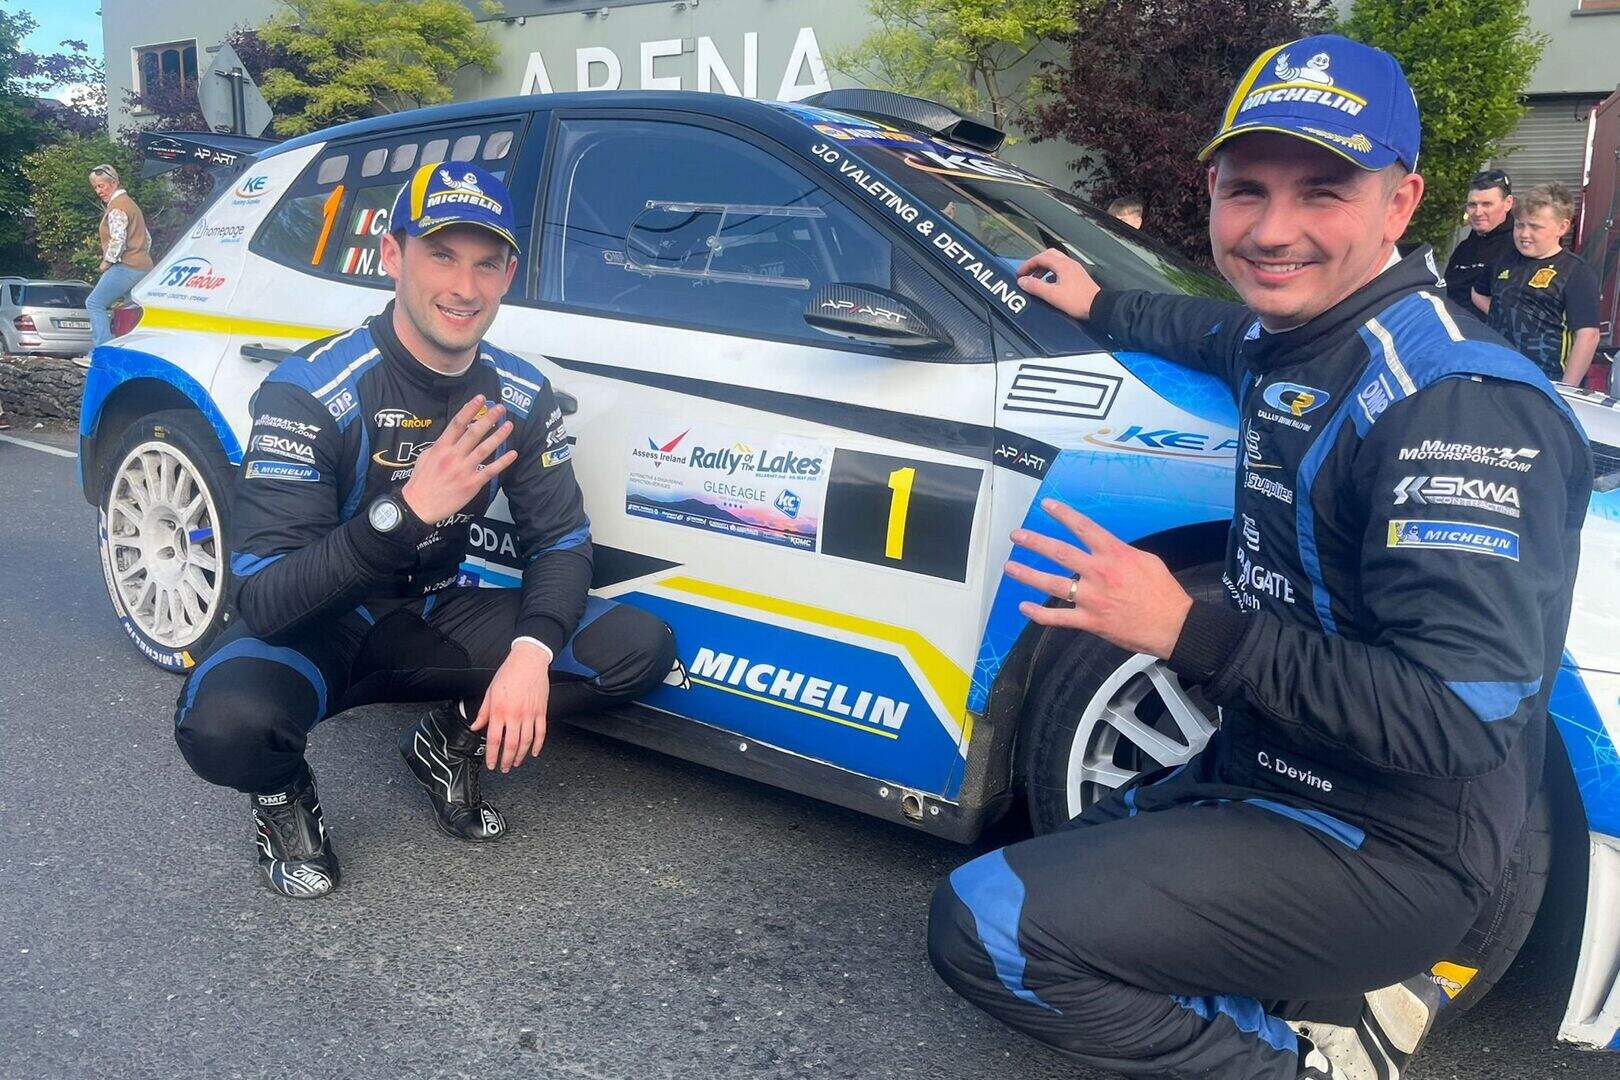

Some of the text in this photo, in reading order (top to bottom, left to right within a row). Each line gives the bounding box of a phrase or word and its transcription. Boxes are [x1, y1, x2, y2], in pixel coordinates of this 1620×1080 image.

[519, 27, 833, 101] ARENA
[1240, 87, 1365, 117] MICHELIN
[242, 176, 268, 192] KE
[427, 193, 503, 216] MICHELIN
[203, 224, 245, 239] homepage
[311, 184, 345, 266] 1
[840, 159, 919, 223] VALETING
[916, 220, 932, 236] &
[933, 232, 1027, 313] DETAILING
[185, 275, 225, 290] GROUP
[501, 386, 531, 408] OMP
[1362, 380, 1388, 415] OMP
[378, 413, 432, 428] TST GROUP
[258, 434, 315, 459] SKWA
[1114, 426, 1209, 450] KE
[1420, 439, 1493, 456] MURRAY
[632, 448, 687, 464] Assess Ireland
[689, 446, 743, 475] Rally
[741, 462, 755, 472] The
[744, 453, 754, 464] Of
[757, 450, 823, 475] Lakes
[1398, 448, 1531, 473] MOTORSPORT.COM
[261, 465, 313, 477] MICHELIN
[704, 481, 766, 502] GLENEAGLE
[1247, 472, 1293, 504] Supplies
[1421, 476, 1521, 508] SKWA
[885, 466, 916, 560] 1
[469, 523, 517, 559] ODA
[1424, 529, 1512, 549] MICHELIN
[124, 621, 173, 666] MICHELIN
[690, 647, 910, 730] MICHELIN
[1258, 751, 1333, 792] C. Devine
[292, 869, 329, 892] OMP
